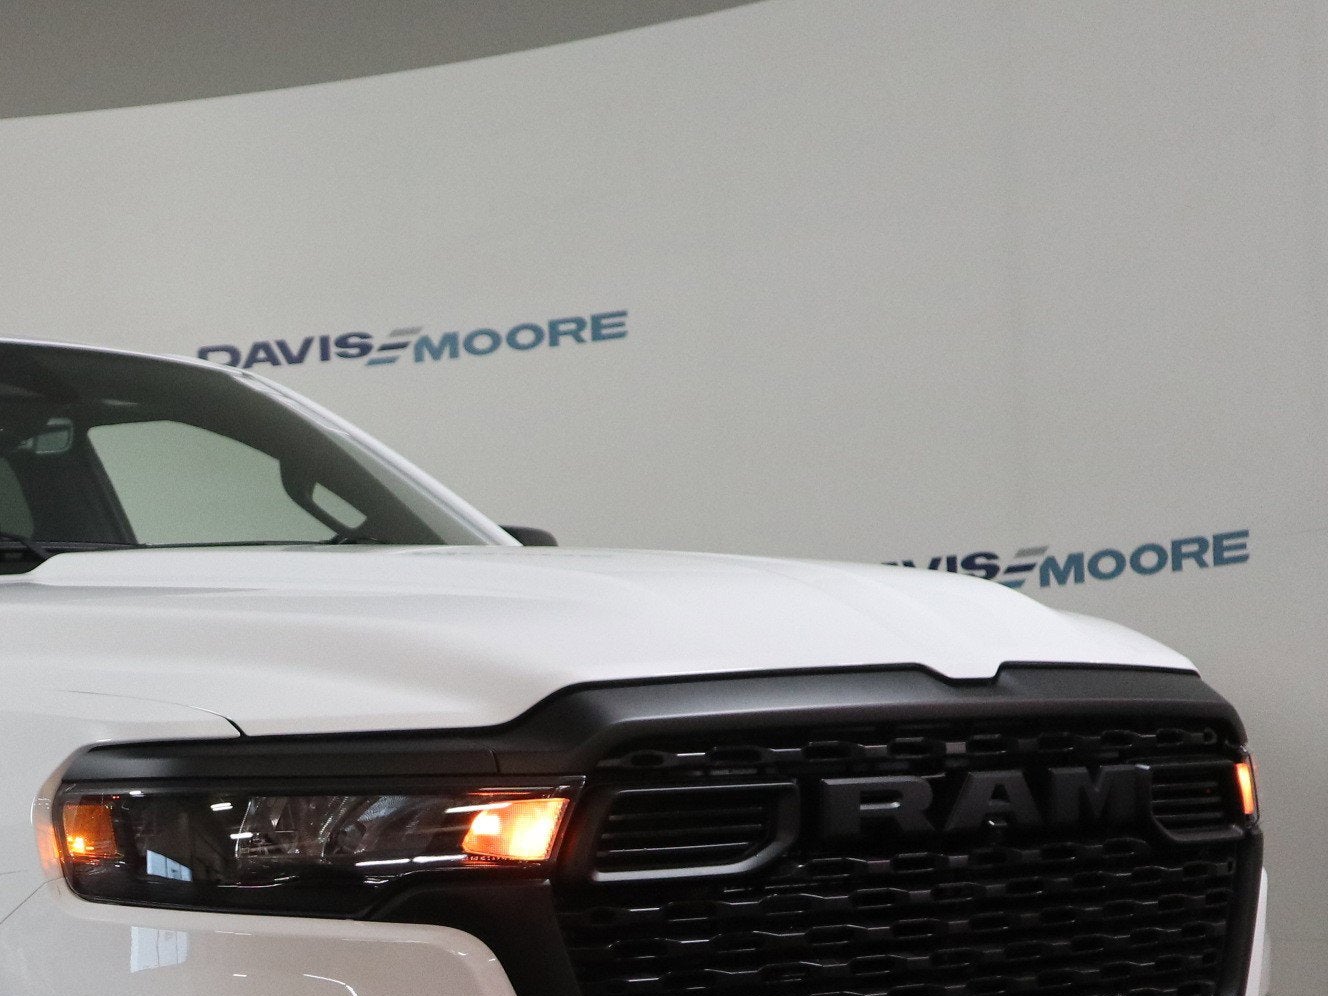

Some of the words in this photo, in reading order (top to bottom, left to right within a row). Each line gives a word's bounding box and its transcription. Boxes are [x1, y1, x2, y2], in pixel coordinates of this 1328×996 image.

[197, 332, 374, 369] DAVIS
[413, 310, 629, 364] MOORE
[1039, 529, 1250, 587] MOORE
[822, 765, 1151, 836] RAM
